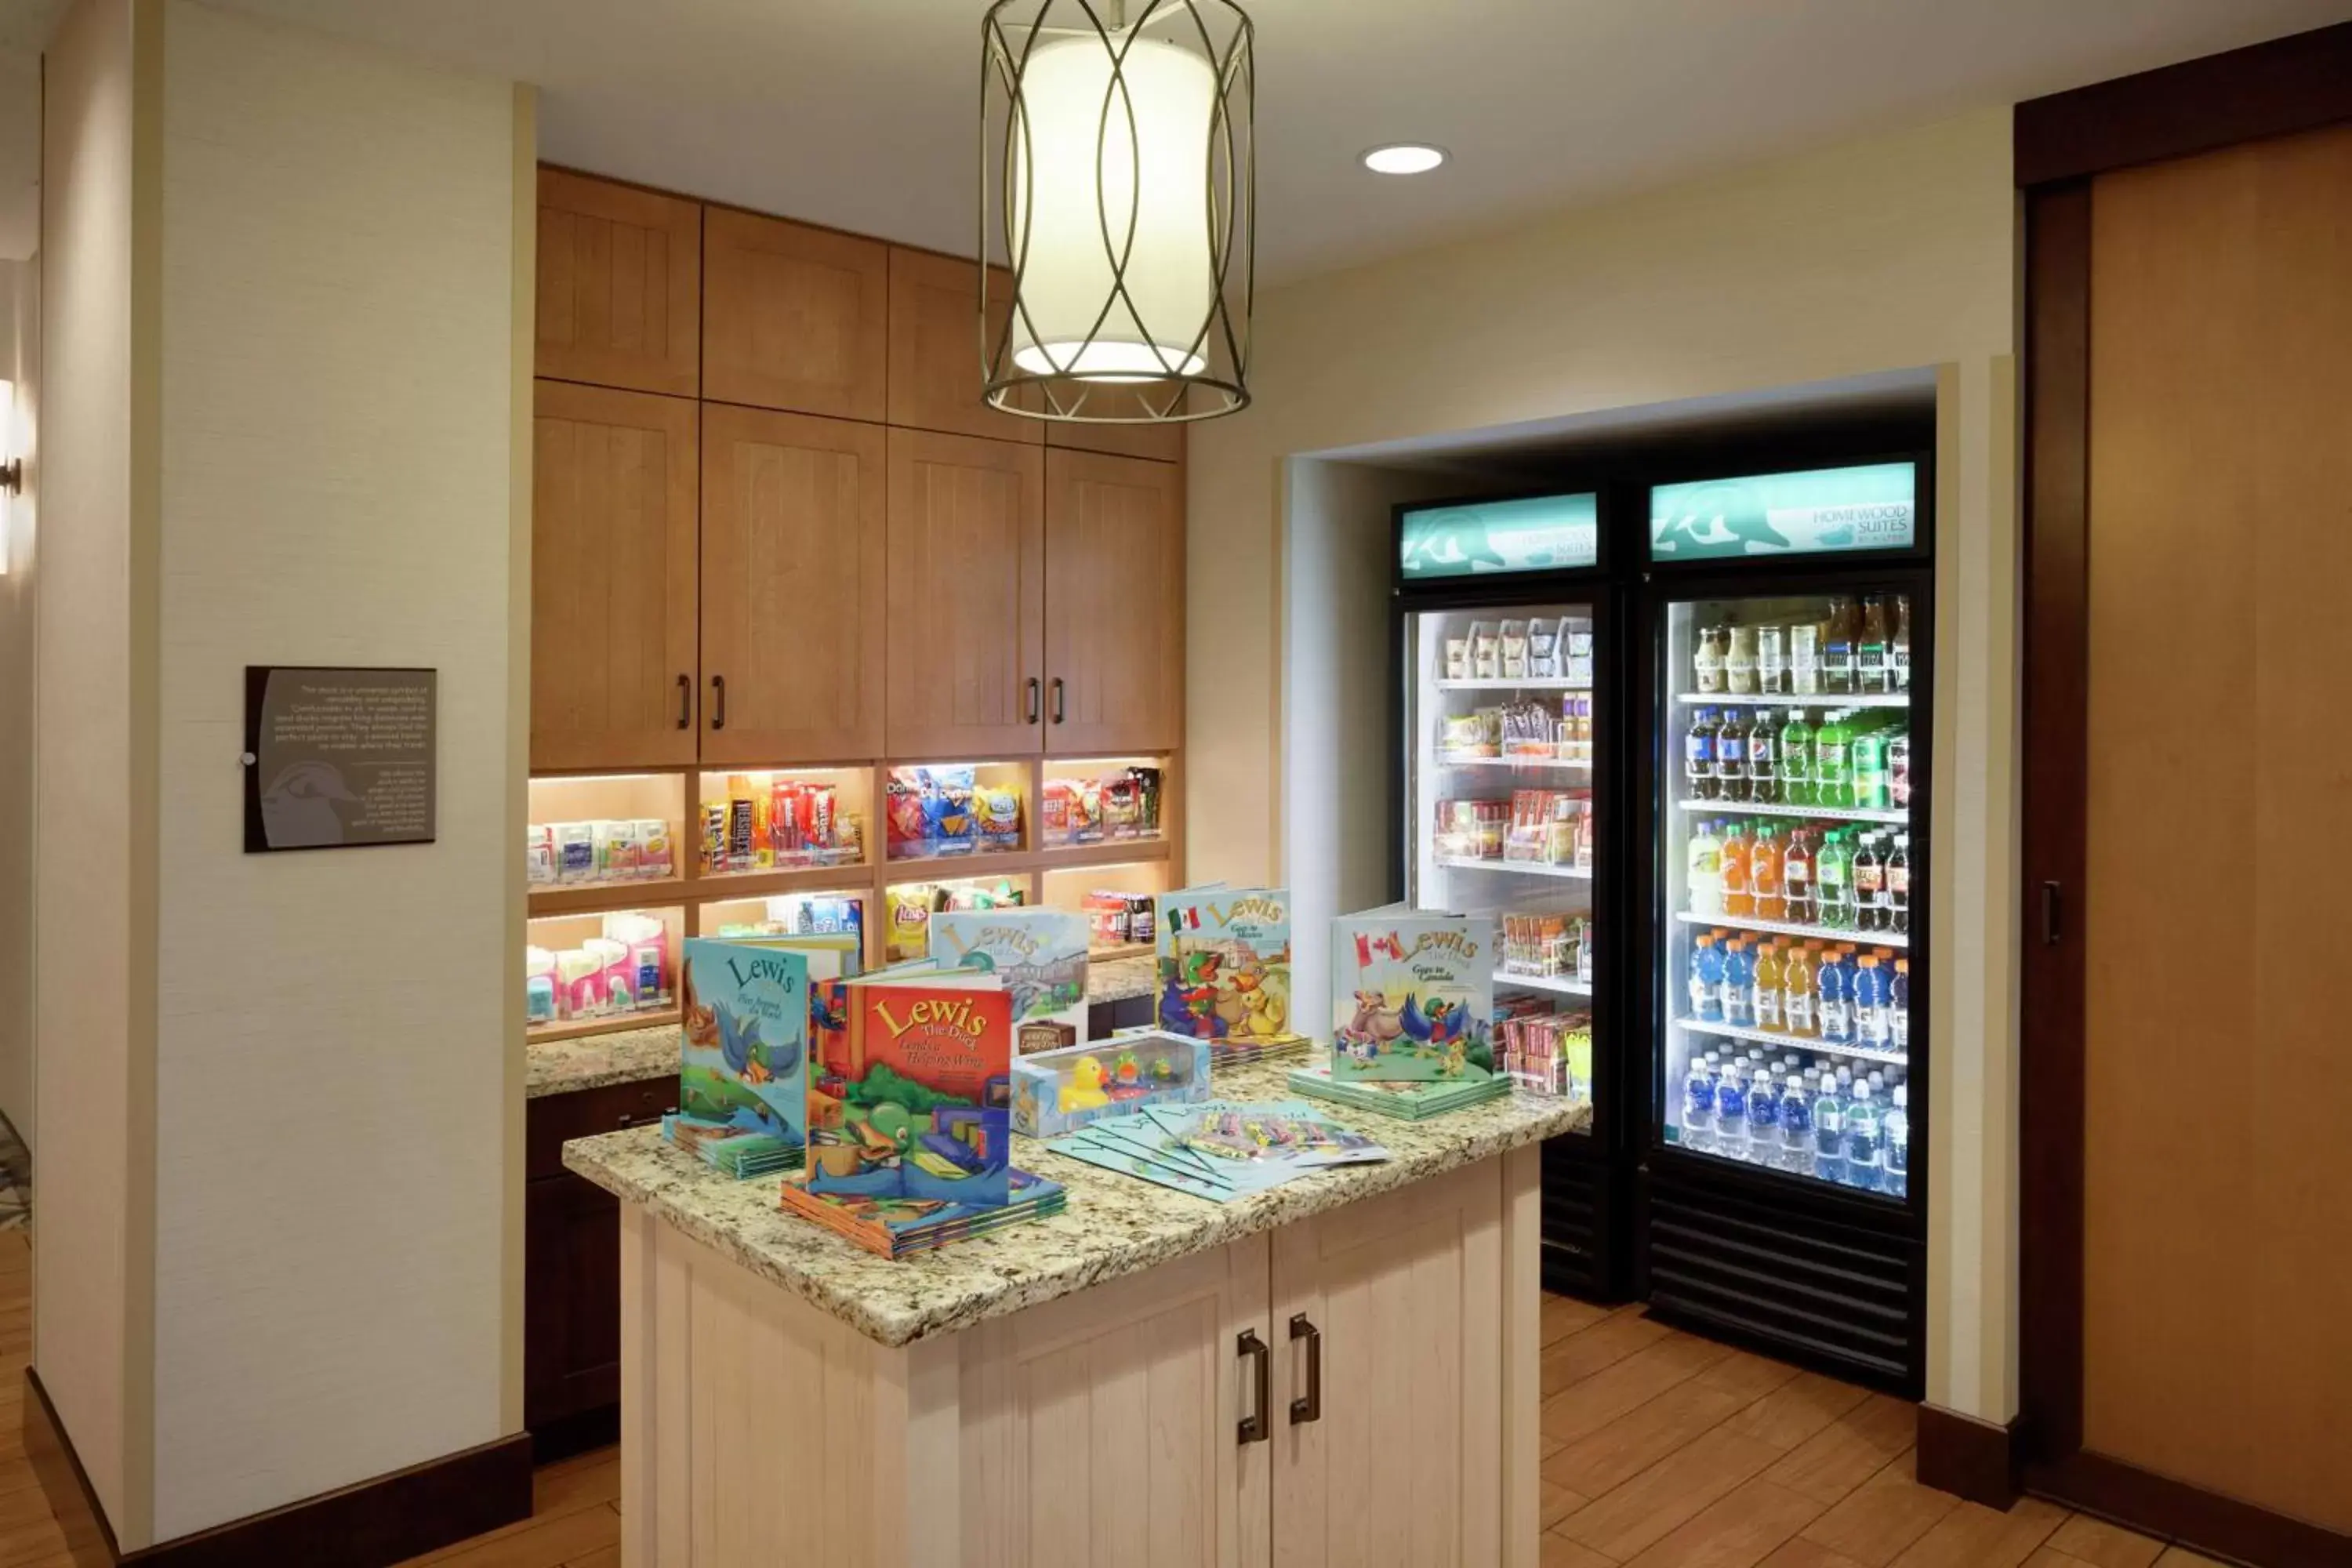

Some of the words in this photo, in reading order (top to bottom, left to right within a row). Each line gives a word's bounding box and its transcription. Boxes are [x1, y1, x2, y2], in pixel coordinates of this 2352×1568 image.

[1813, 506, 1907, 523] HOMEWOOD
[1858, 519, 1907, 534] SUITES
[1206, 894, 1283, 928] Lewis
[941, 922, 1040, 956] Lewis
[1387, 927, 1478, 963] Lewis
[728, 956, 794, 993] Lewis
[872, 998, 987, 1039] Lewis
